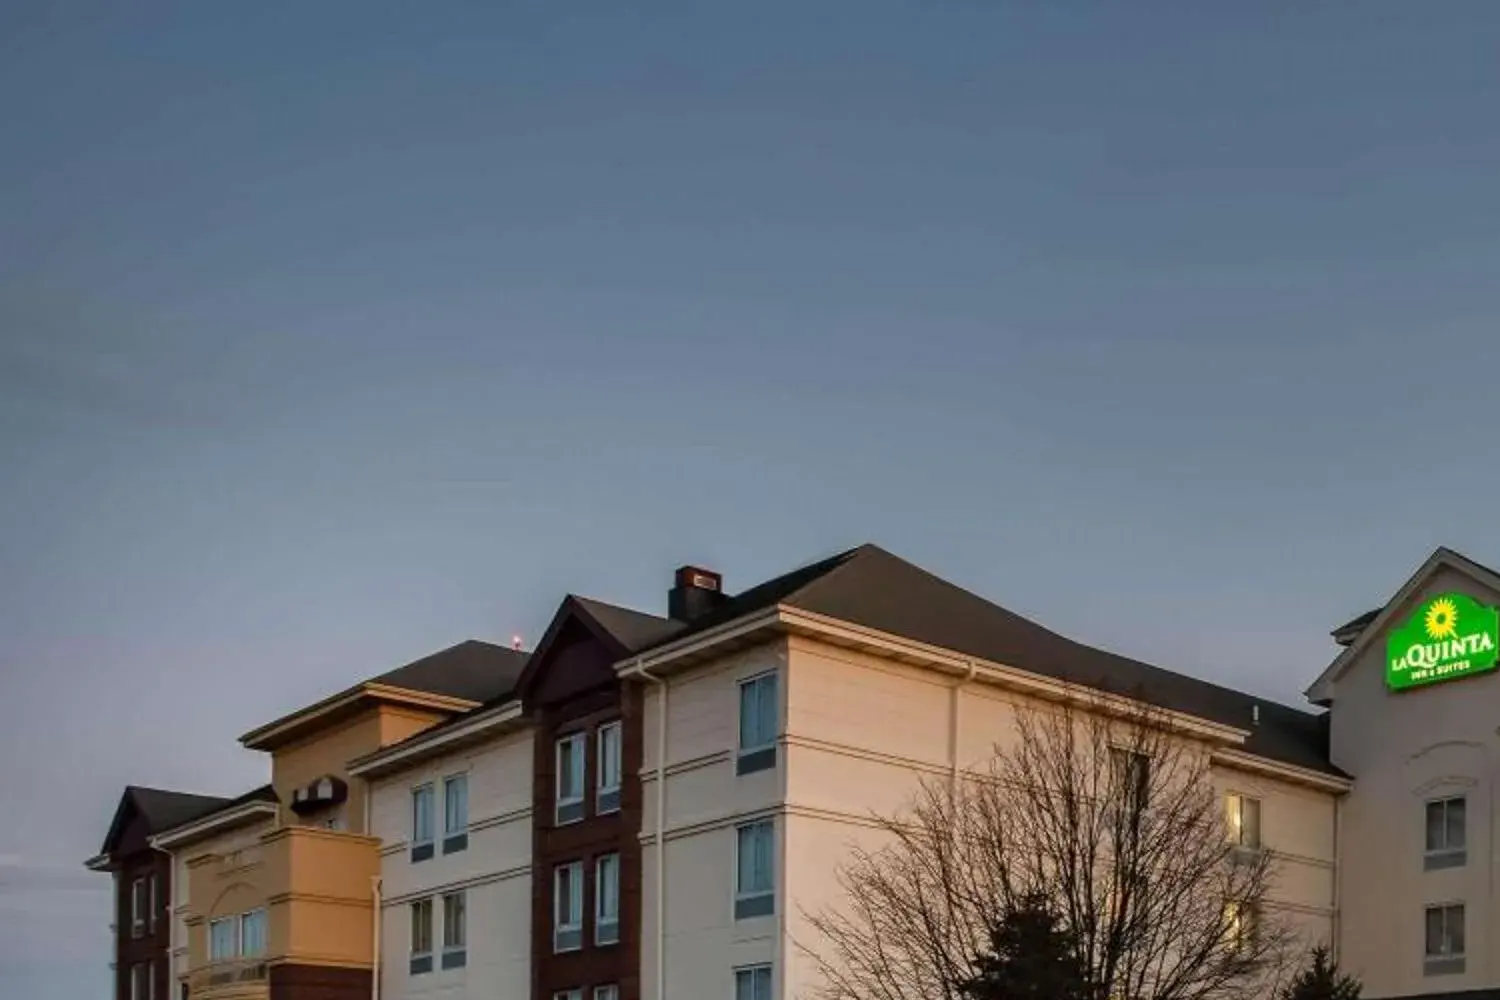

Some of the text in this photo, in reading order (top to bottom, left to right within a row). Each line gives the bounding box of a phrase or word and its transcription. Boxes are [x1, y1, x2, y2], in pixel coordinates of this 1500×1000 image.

[1392, 632, 1494, 671] LA QUINTA
[1436, 660, 1470, 675] SUITES
